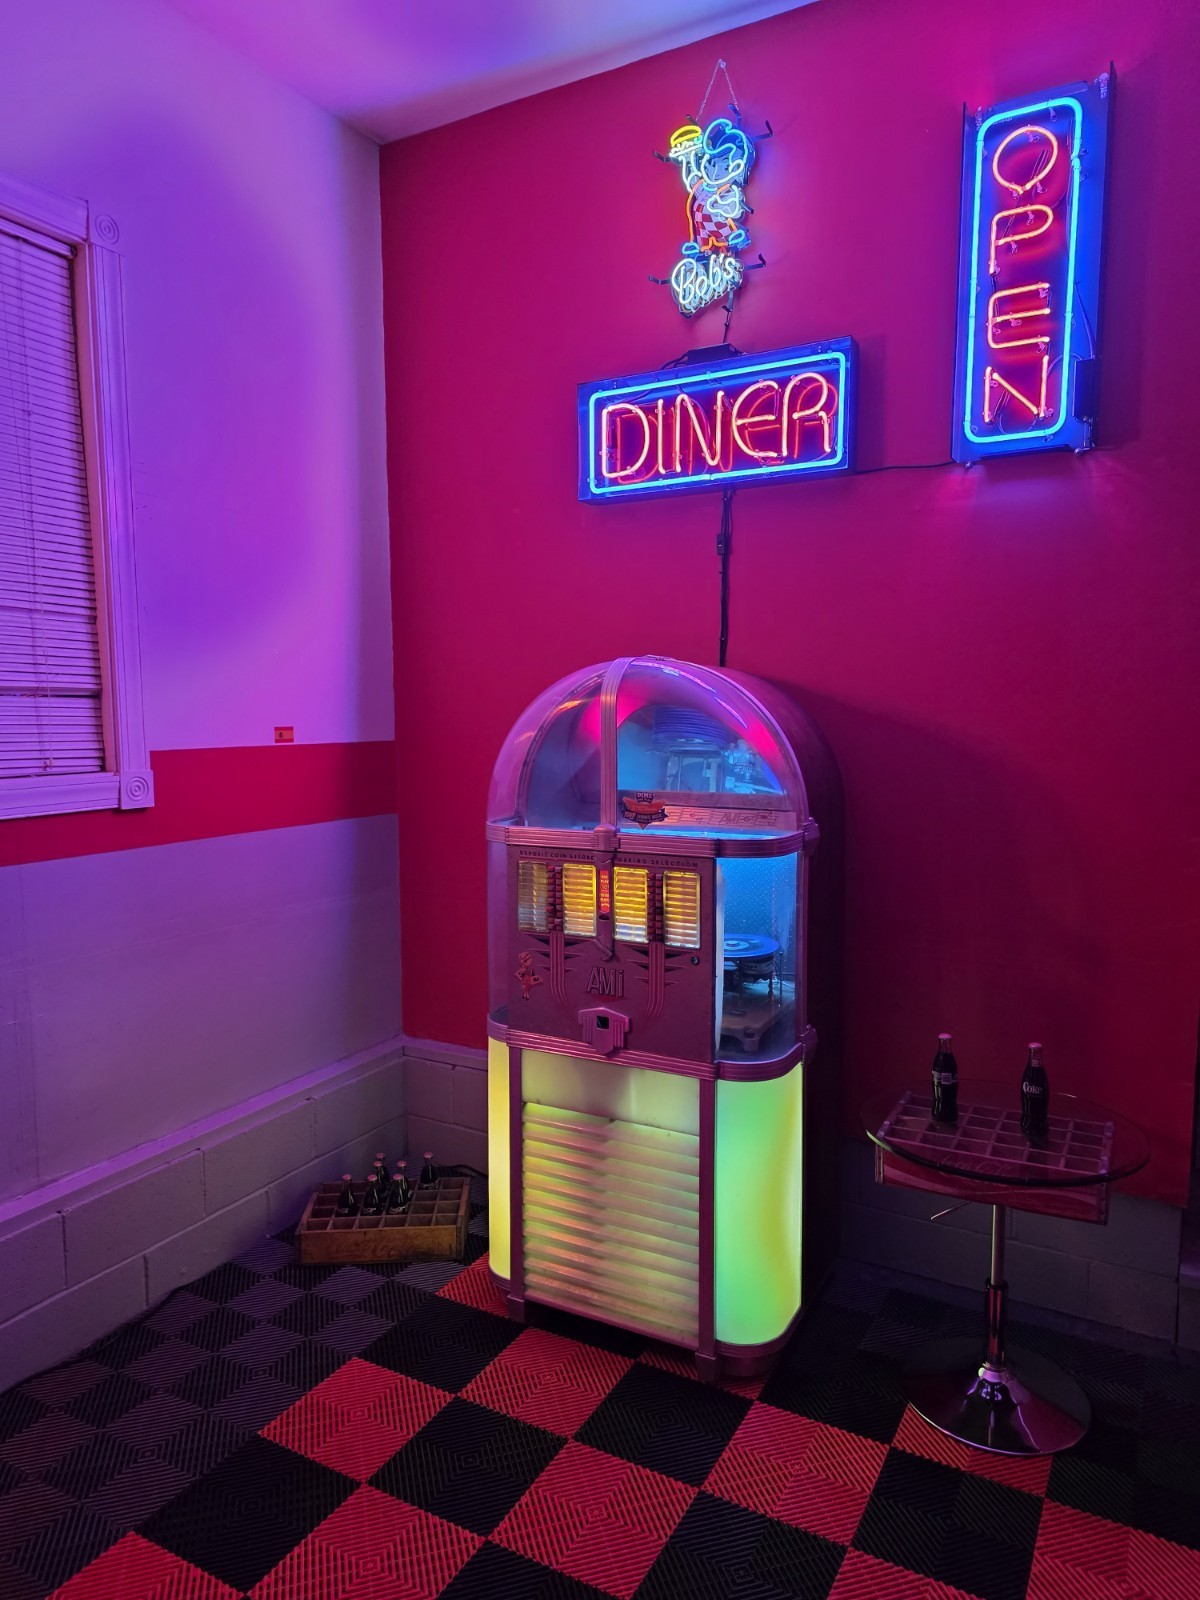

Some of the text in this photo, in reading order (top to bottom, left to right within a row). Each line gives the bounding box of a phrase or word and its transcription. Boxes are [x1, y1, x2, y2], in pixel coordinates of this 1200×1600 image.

[671, 253, 736, 304] Bob's
[983, 125, 1060, 424] OPEN
[600, 371, 832, 479] DINER
[519, 850, 548, 858] DEPOSIT
[651, 859, 698, 867] SELECTION
[1022, 1081, 1043, 1094] Coke
